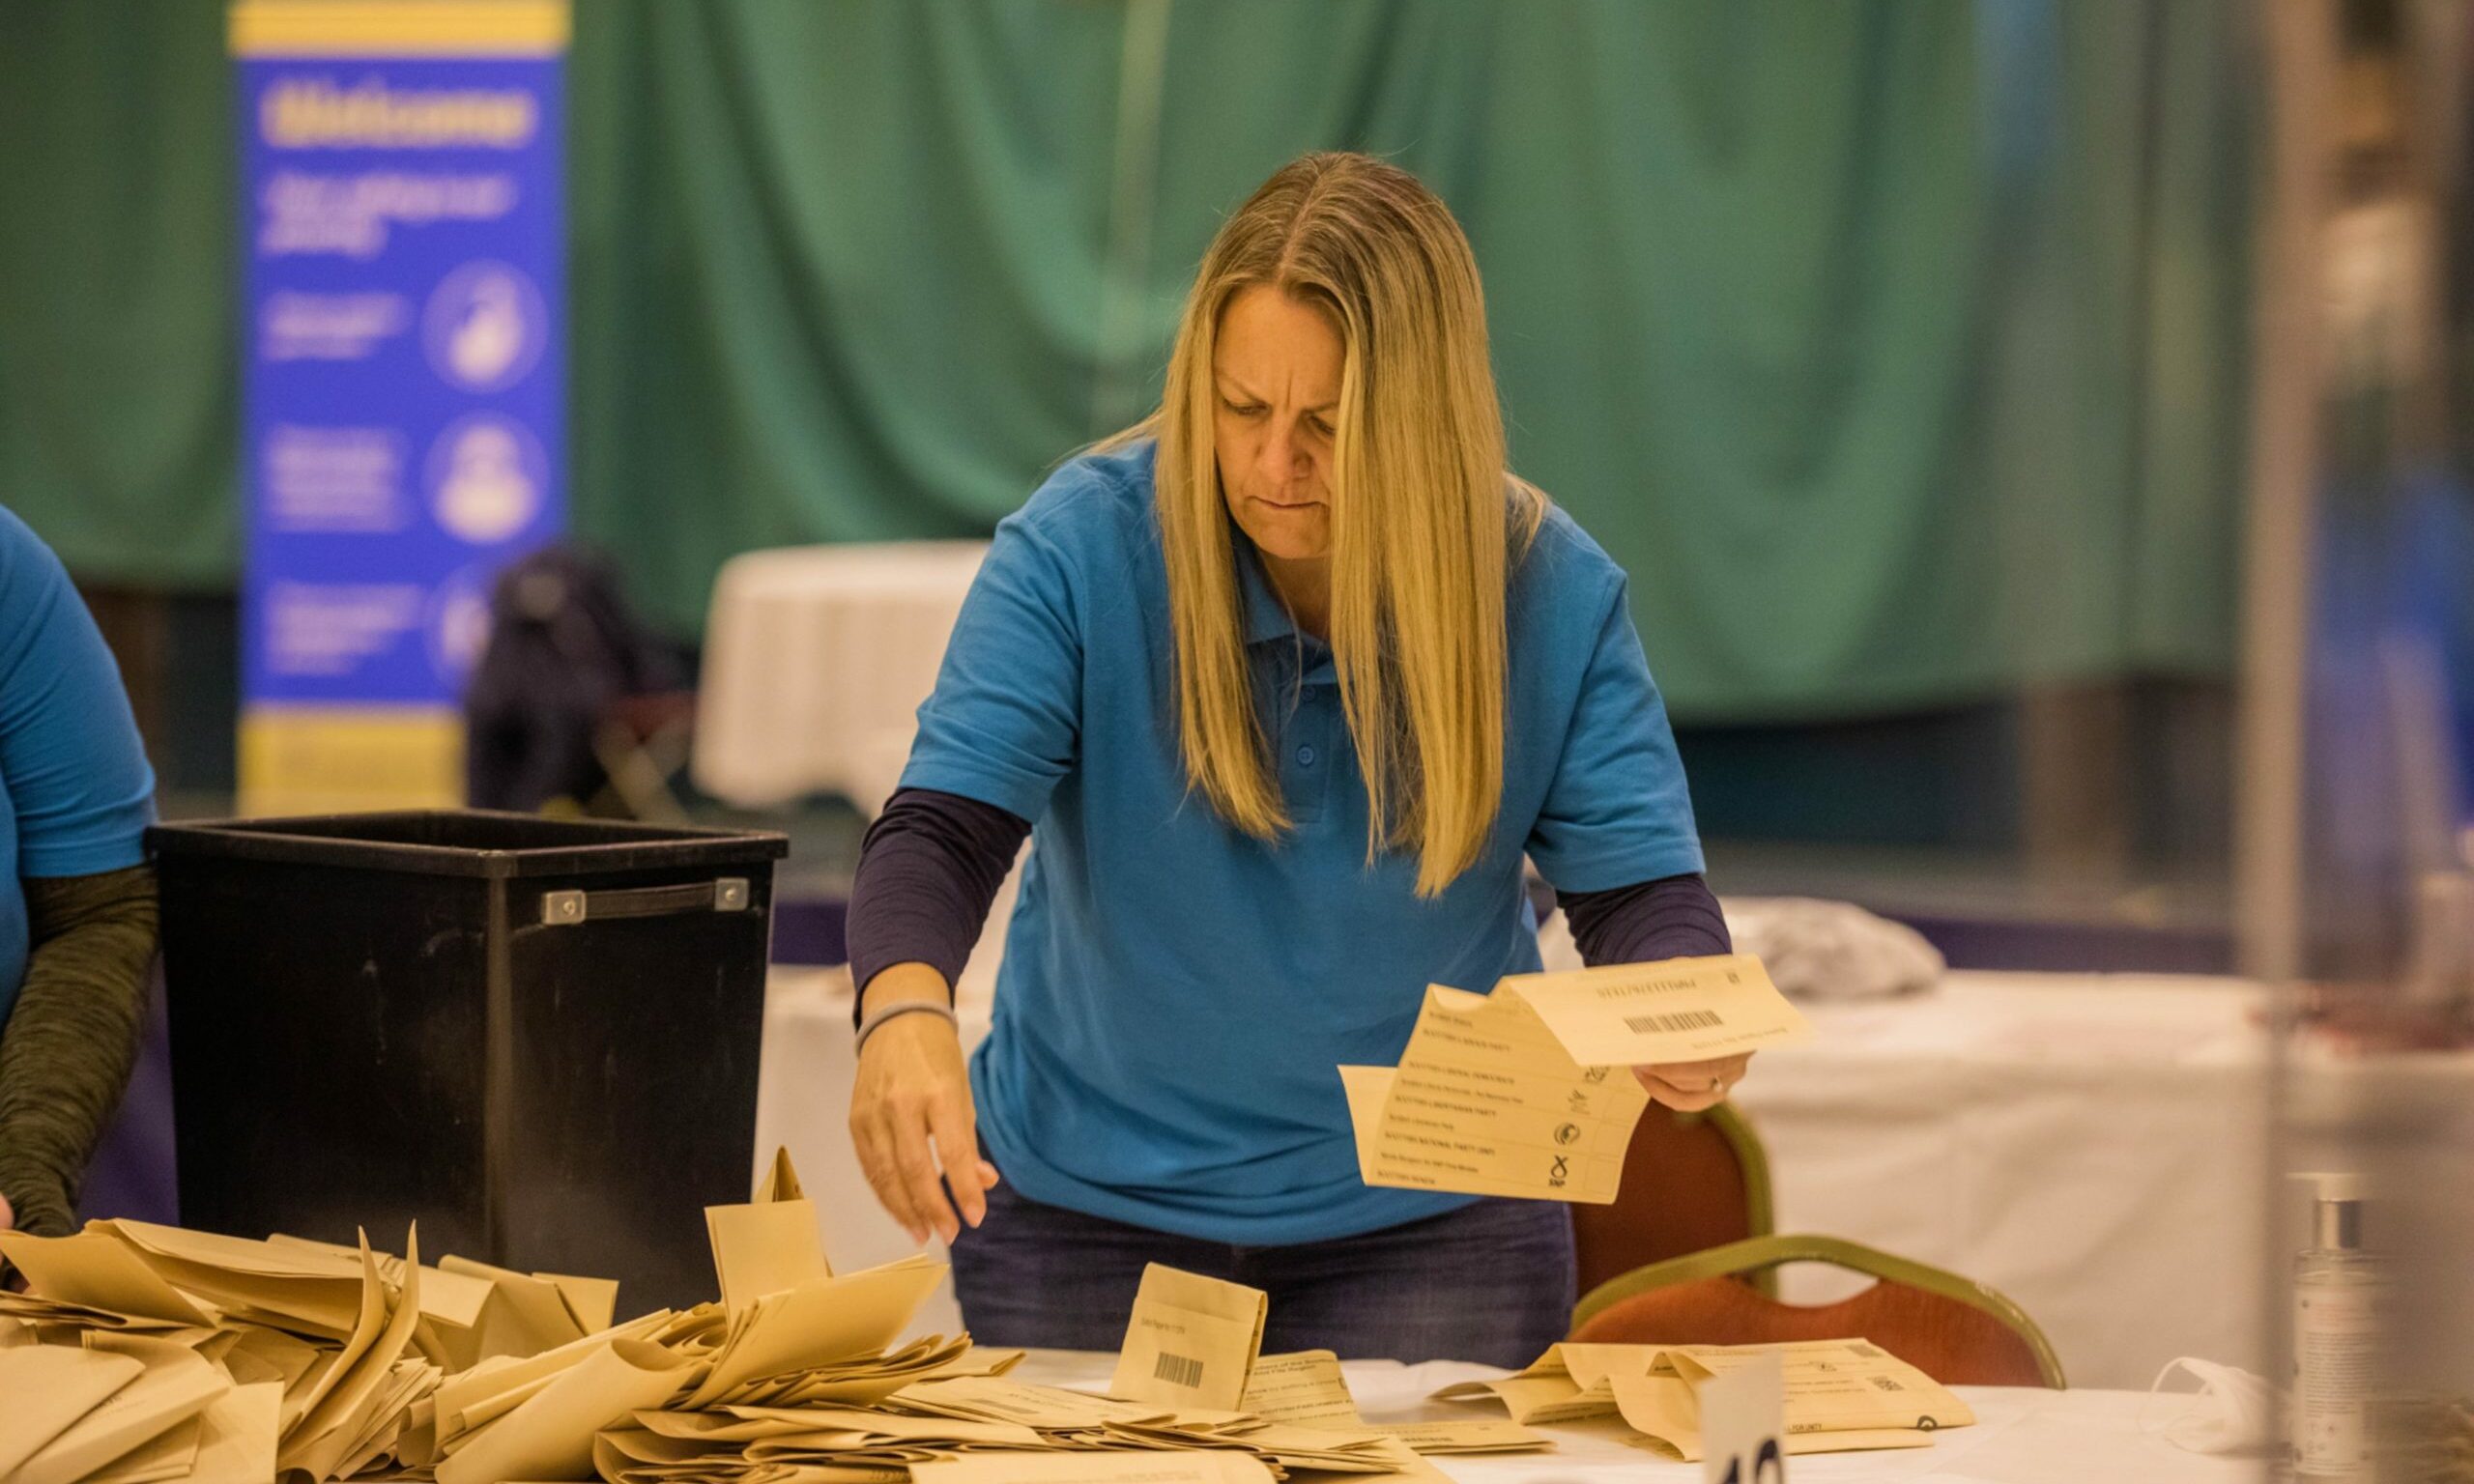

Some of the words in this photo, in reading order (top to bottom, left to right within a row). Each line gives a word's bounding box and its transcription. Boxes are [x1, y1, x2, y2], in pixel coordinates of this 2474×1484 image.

[1385, 1131, 1419, 1145] SCOTTISH
[1454, 1142, 1476, 1154] PARTY
[1549, 1179, 1566, 1187] SNP
